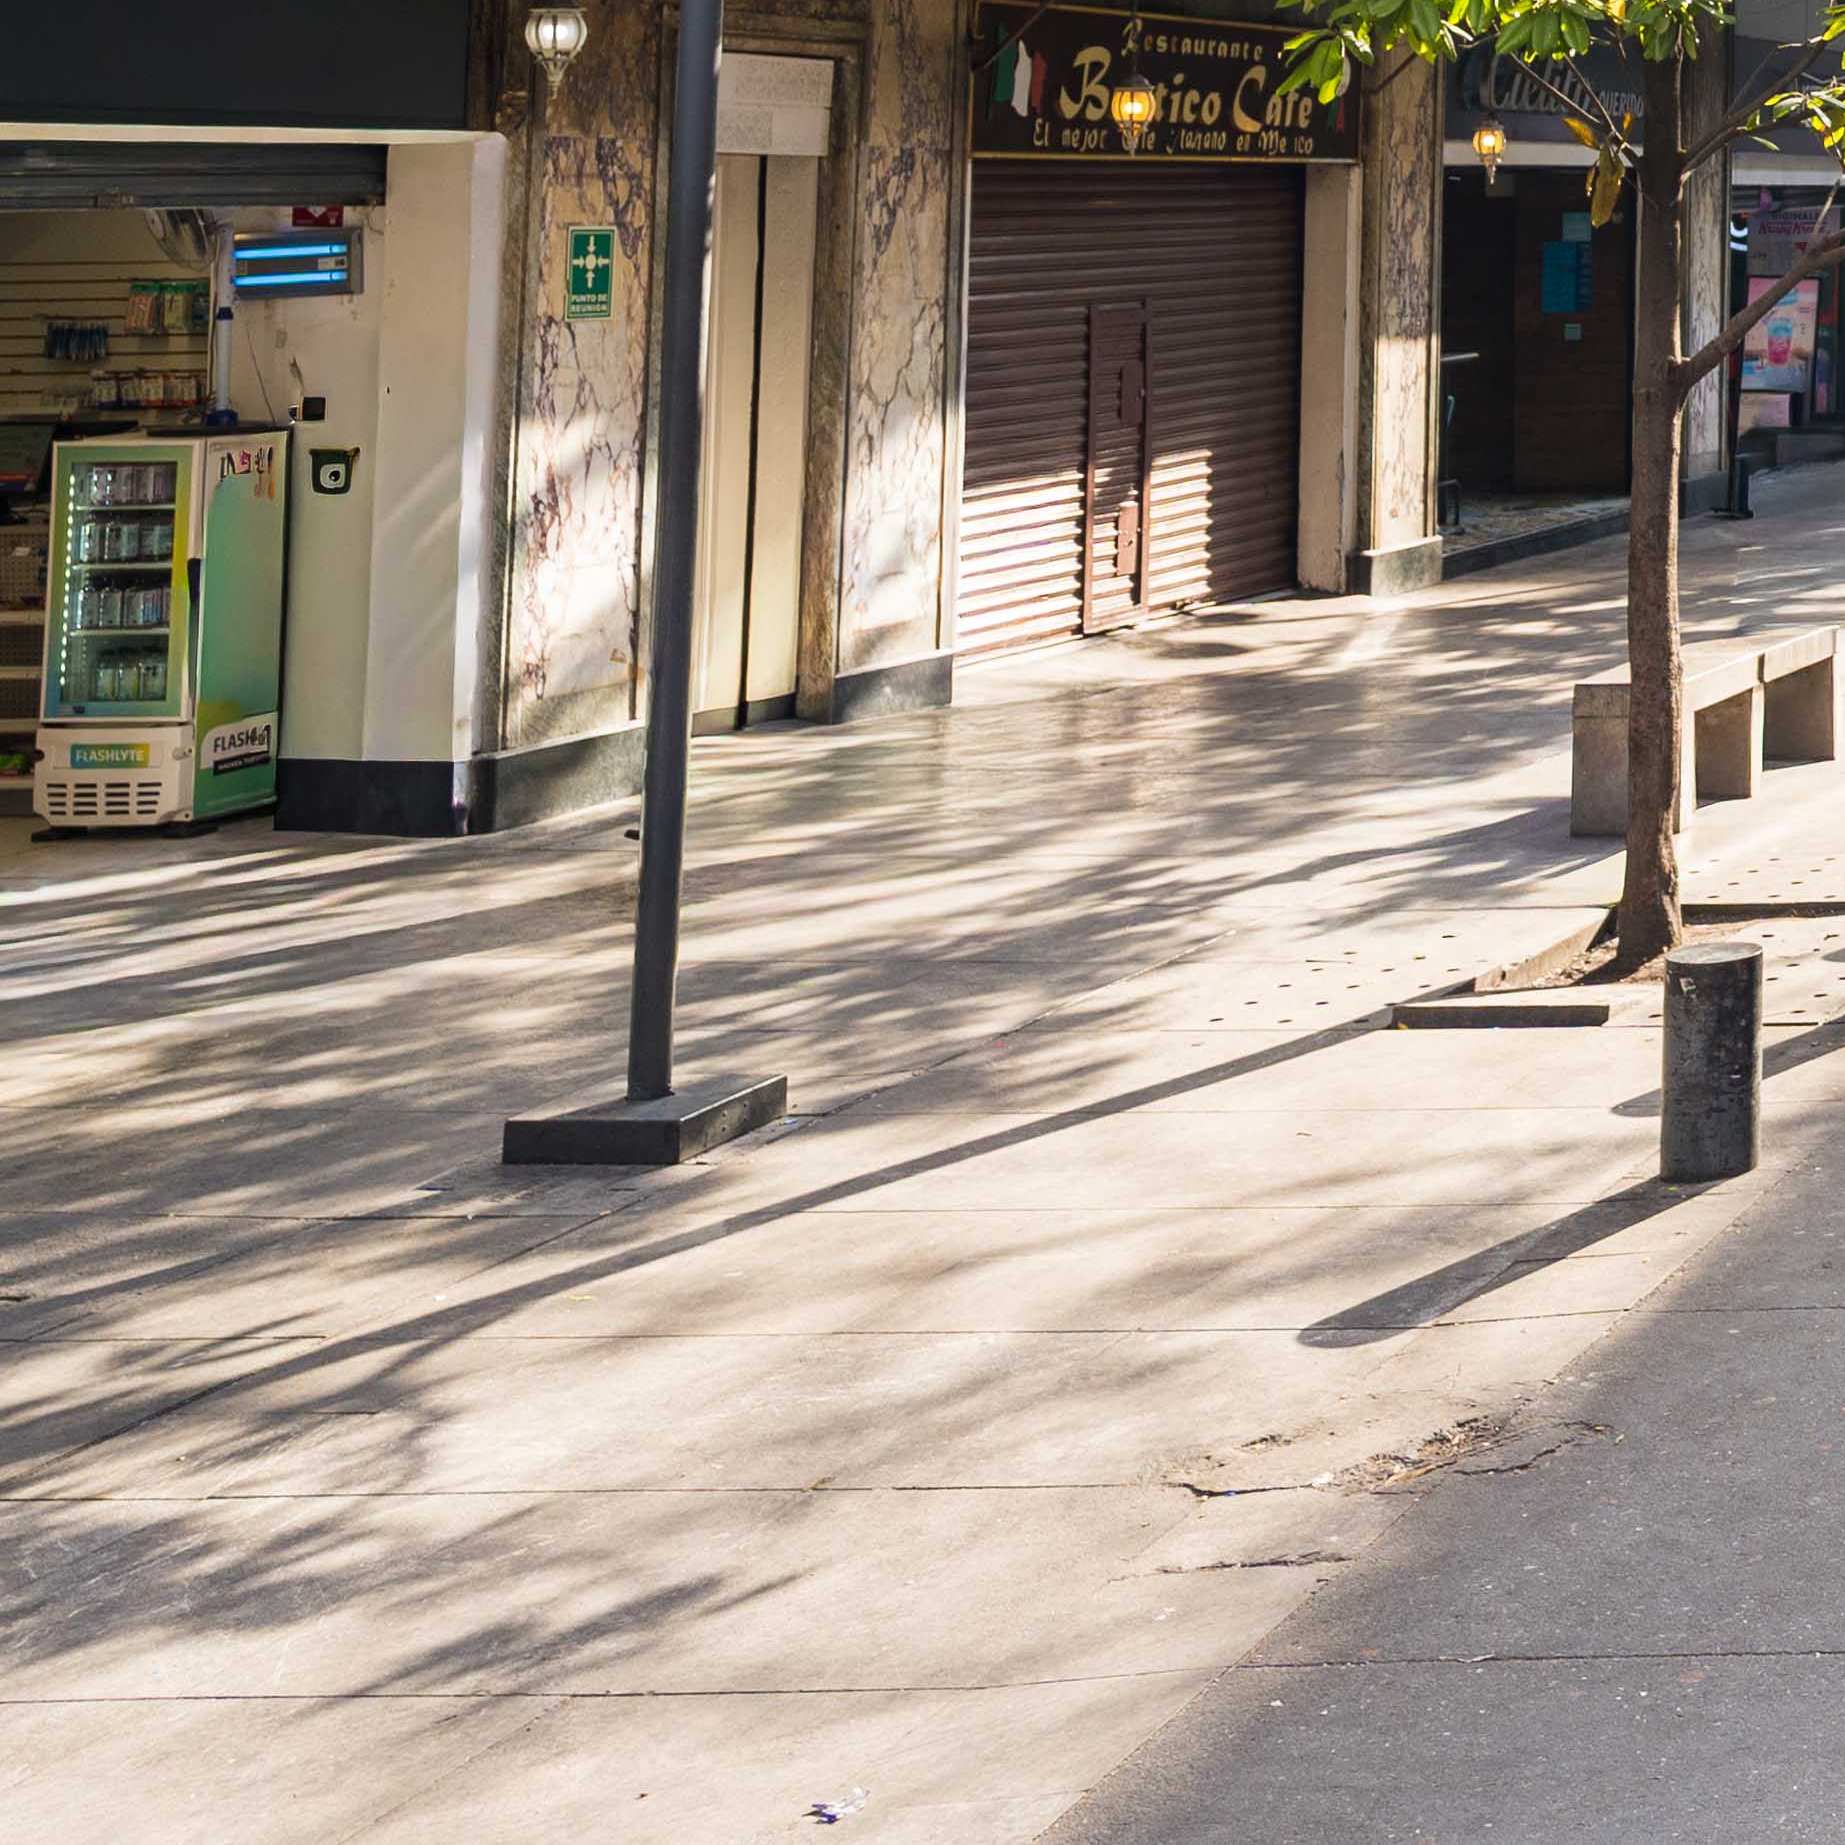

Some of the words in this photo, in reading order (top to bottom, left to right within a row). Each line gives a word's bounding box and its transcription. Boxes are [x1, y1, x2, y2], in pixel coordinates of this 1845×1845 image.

[1121, 18, 1264, 61] Restaurante
[1032, 117, 1050, 147] El
[1061, 127, 1107, 153] mejor
[75, 748, 146, 762] FLASHLYTE
